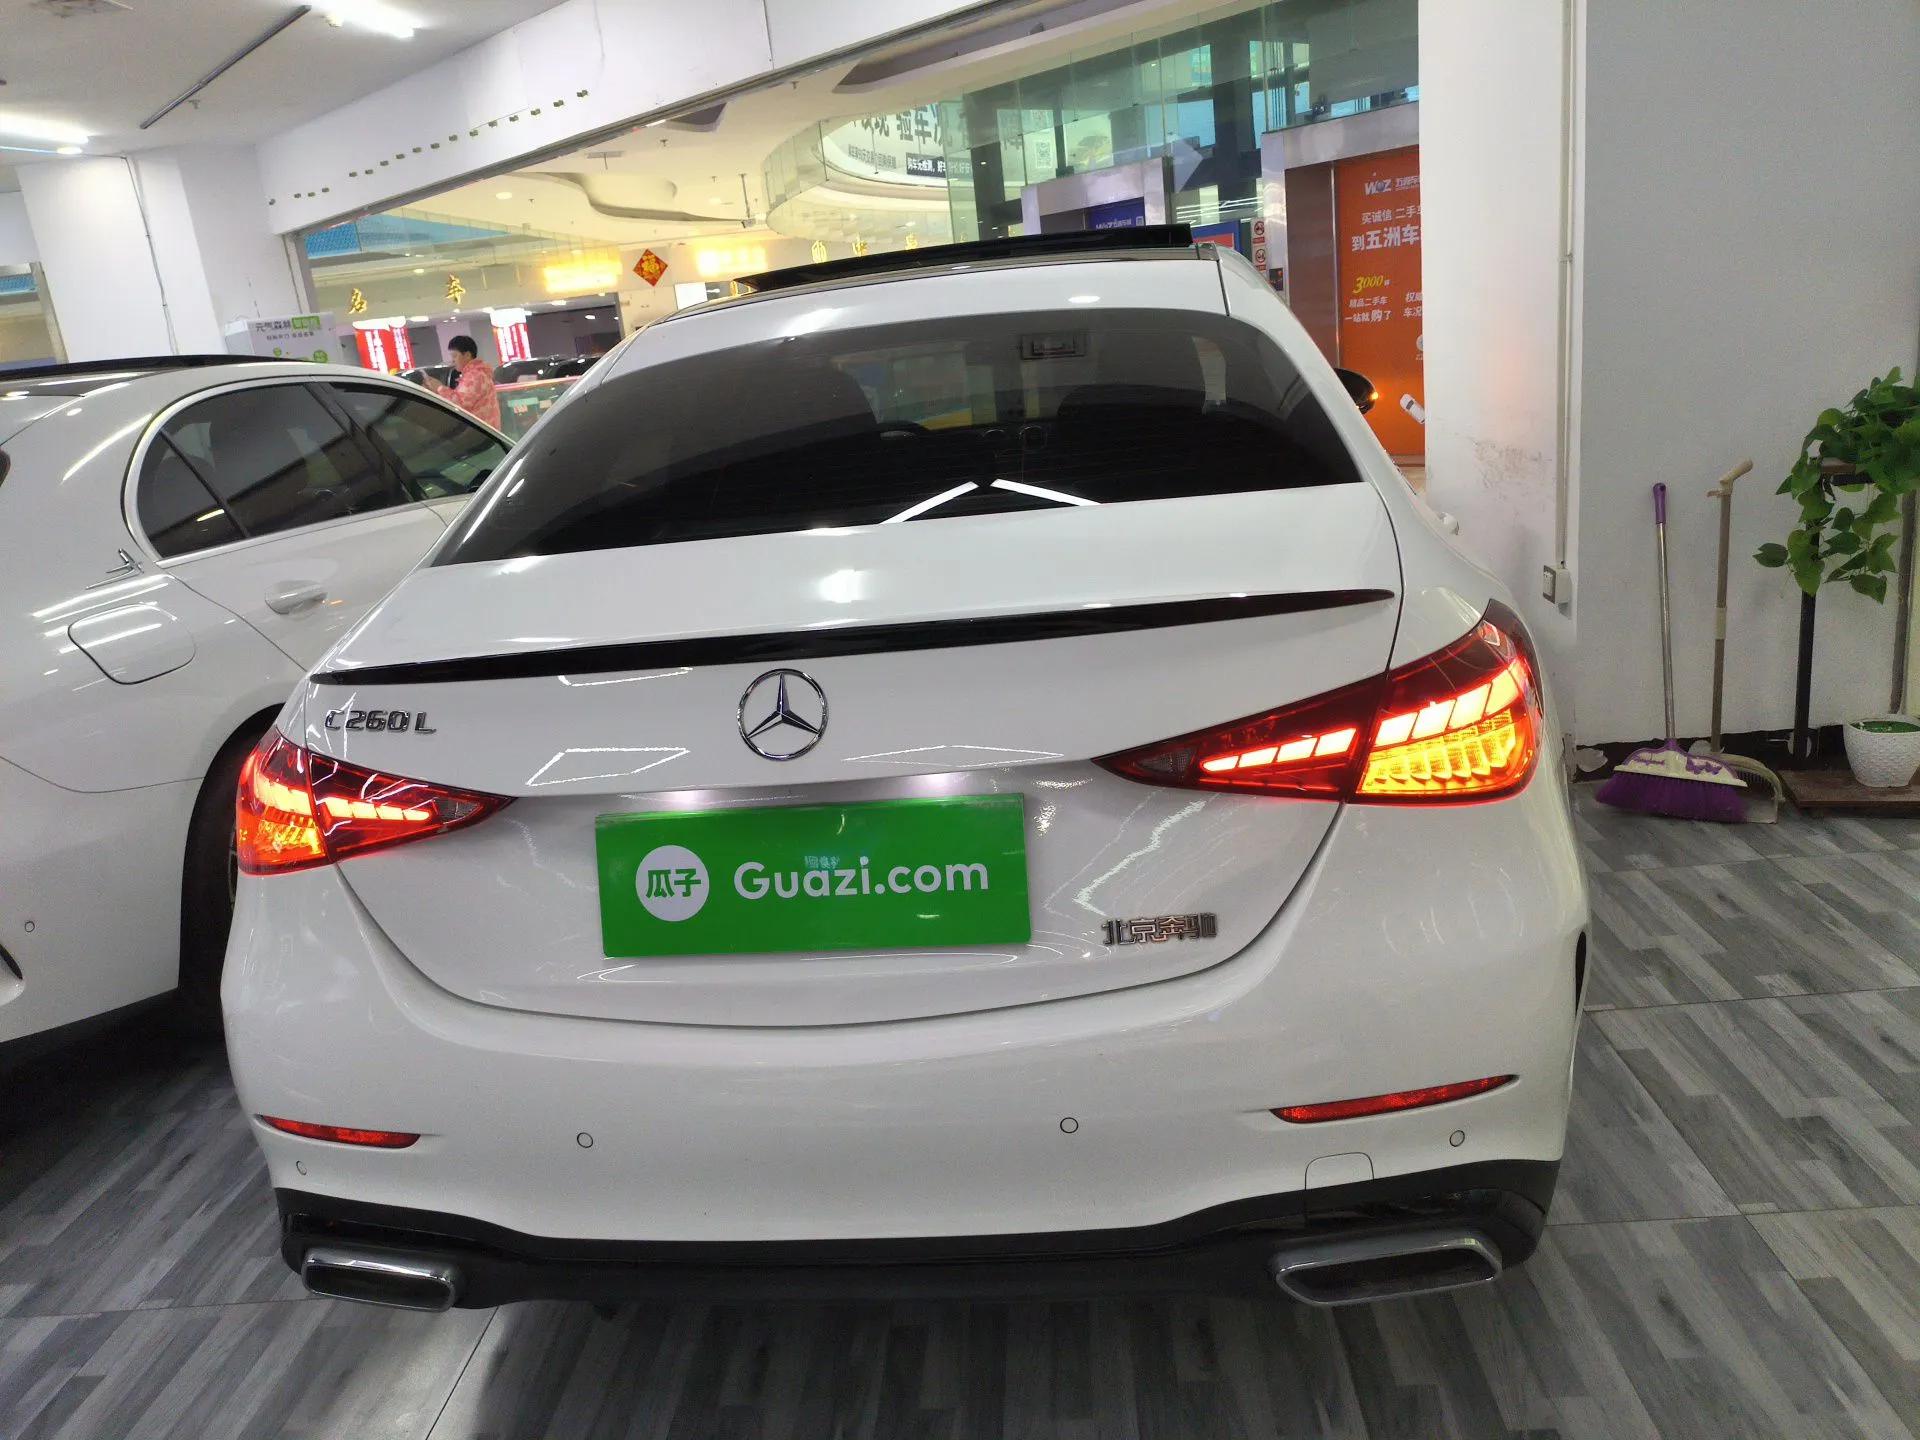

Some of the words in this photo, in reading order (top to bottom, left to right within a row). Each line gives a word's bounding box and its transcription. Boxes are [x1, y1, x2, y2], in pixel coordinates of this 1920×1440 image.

[1361, 208, 1392, 226] 买诚信
[1351, 224, 1420, 252] 到五洲车
[645, 867, 702, 900] 瓜子
[733, 856, 989, 900] Guazi.com
[1101, 912, 1218, 945] 北京奔驰
